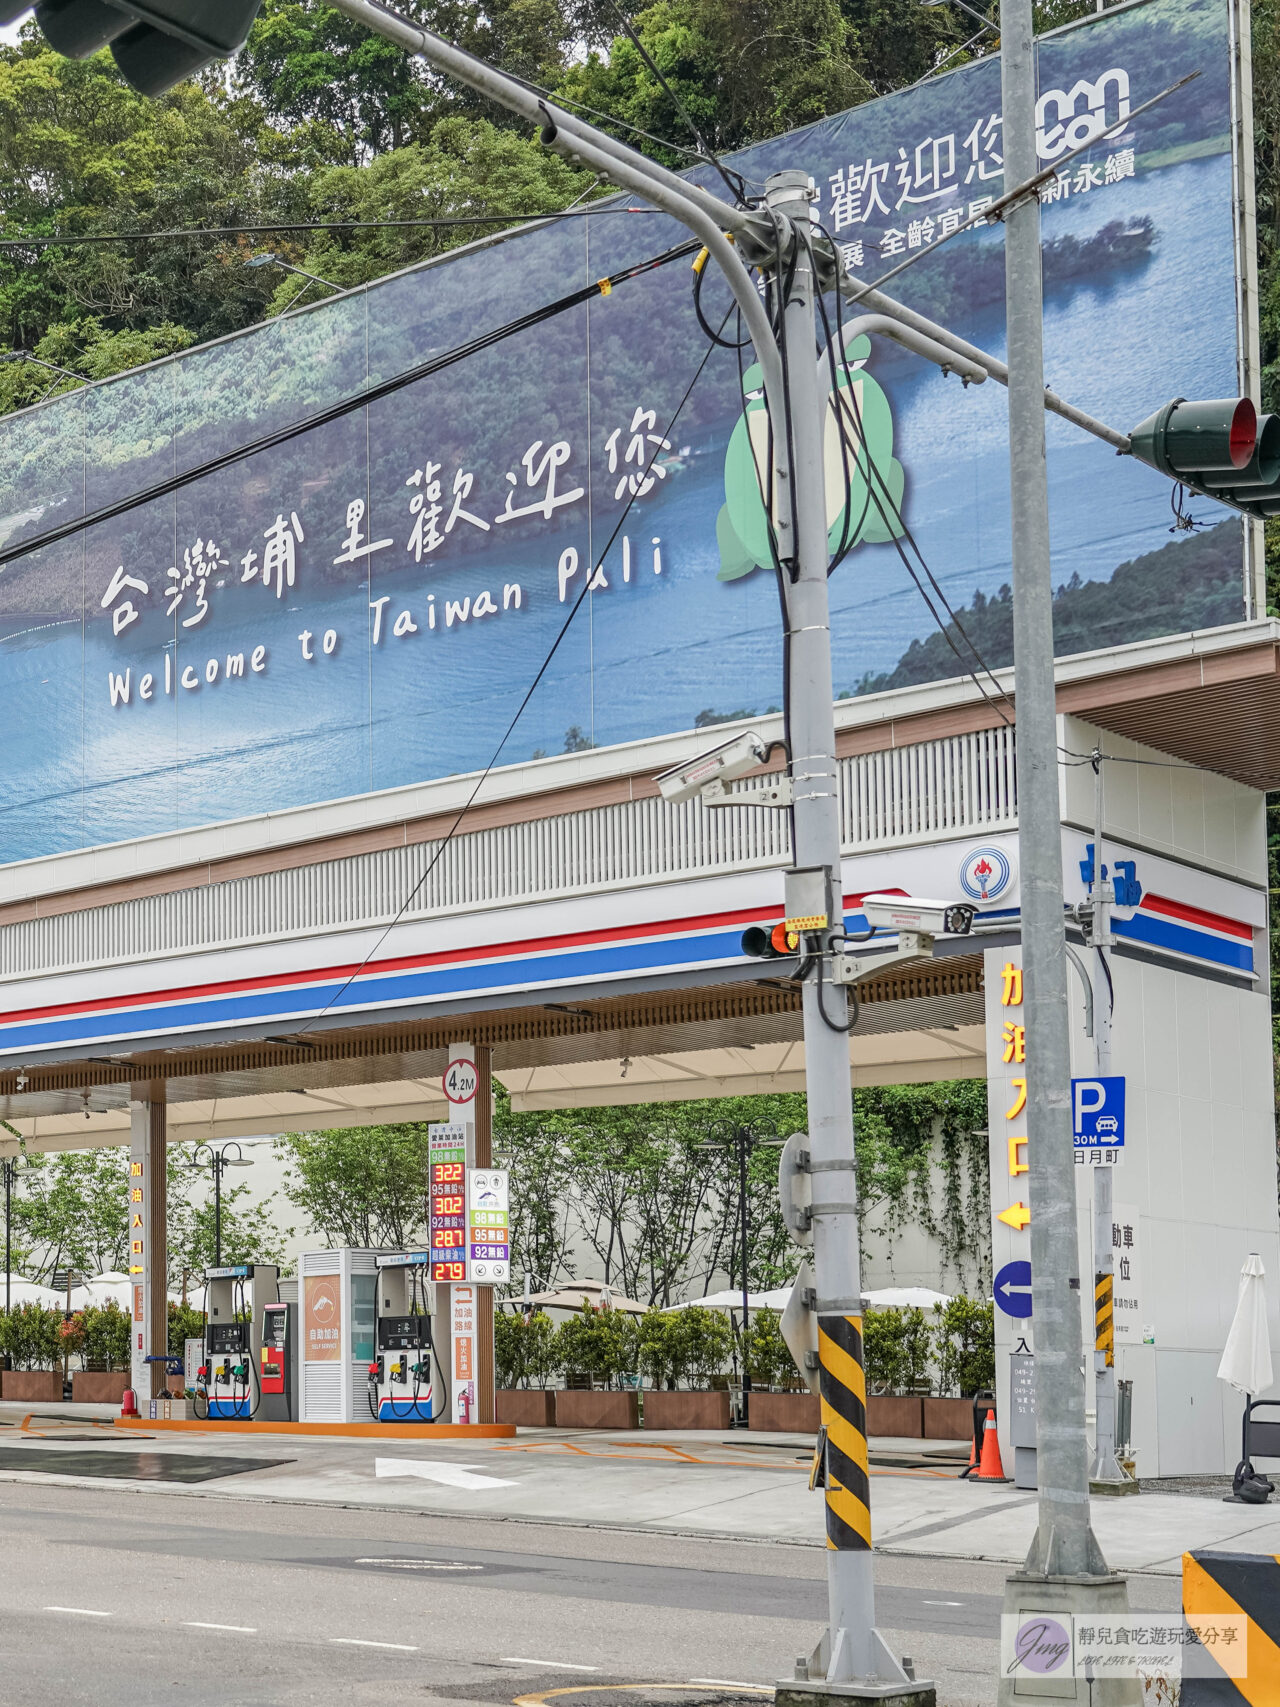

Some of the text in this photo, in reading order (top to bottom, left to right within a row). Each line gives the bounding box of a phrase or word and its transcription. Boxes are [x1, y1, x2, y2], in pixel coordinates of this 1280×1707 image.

[101, 407, 671, 635] 台灣埔里歡迎您
[109, 536, 662, 706] Welcome to Taiwan Puli
[448, 1071, 474, 1091] 4.2M
[1075, 1081, 1106, 1133] P
[1074, 1149, 1119, 1165] 日月町
[131, 1162, 143, 1254] 加油入口
[475, 1229, 504, 1242] 95無鉛
[475, 1245, 505, 1259] 92無鉛
[1120, 1256, 1131, 1281] 位
[1015, 1337, 1031, 1353] 入
